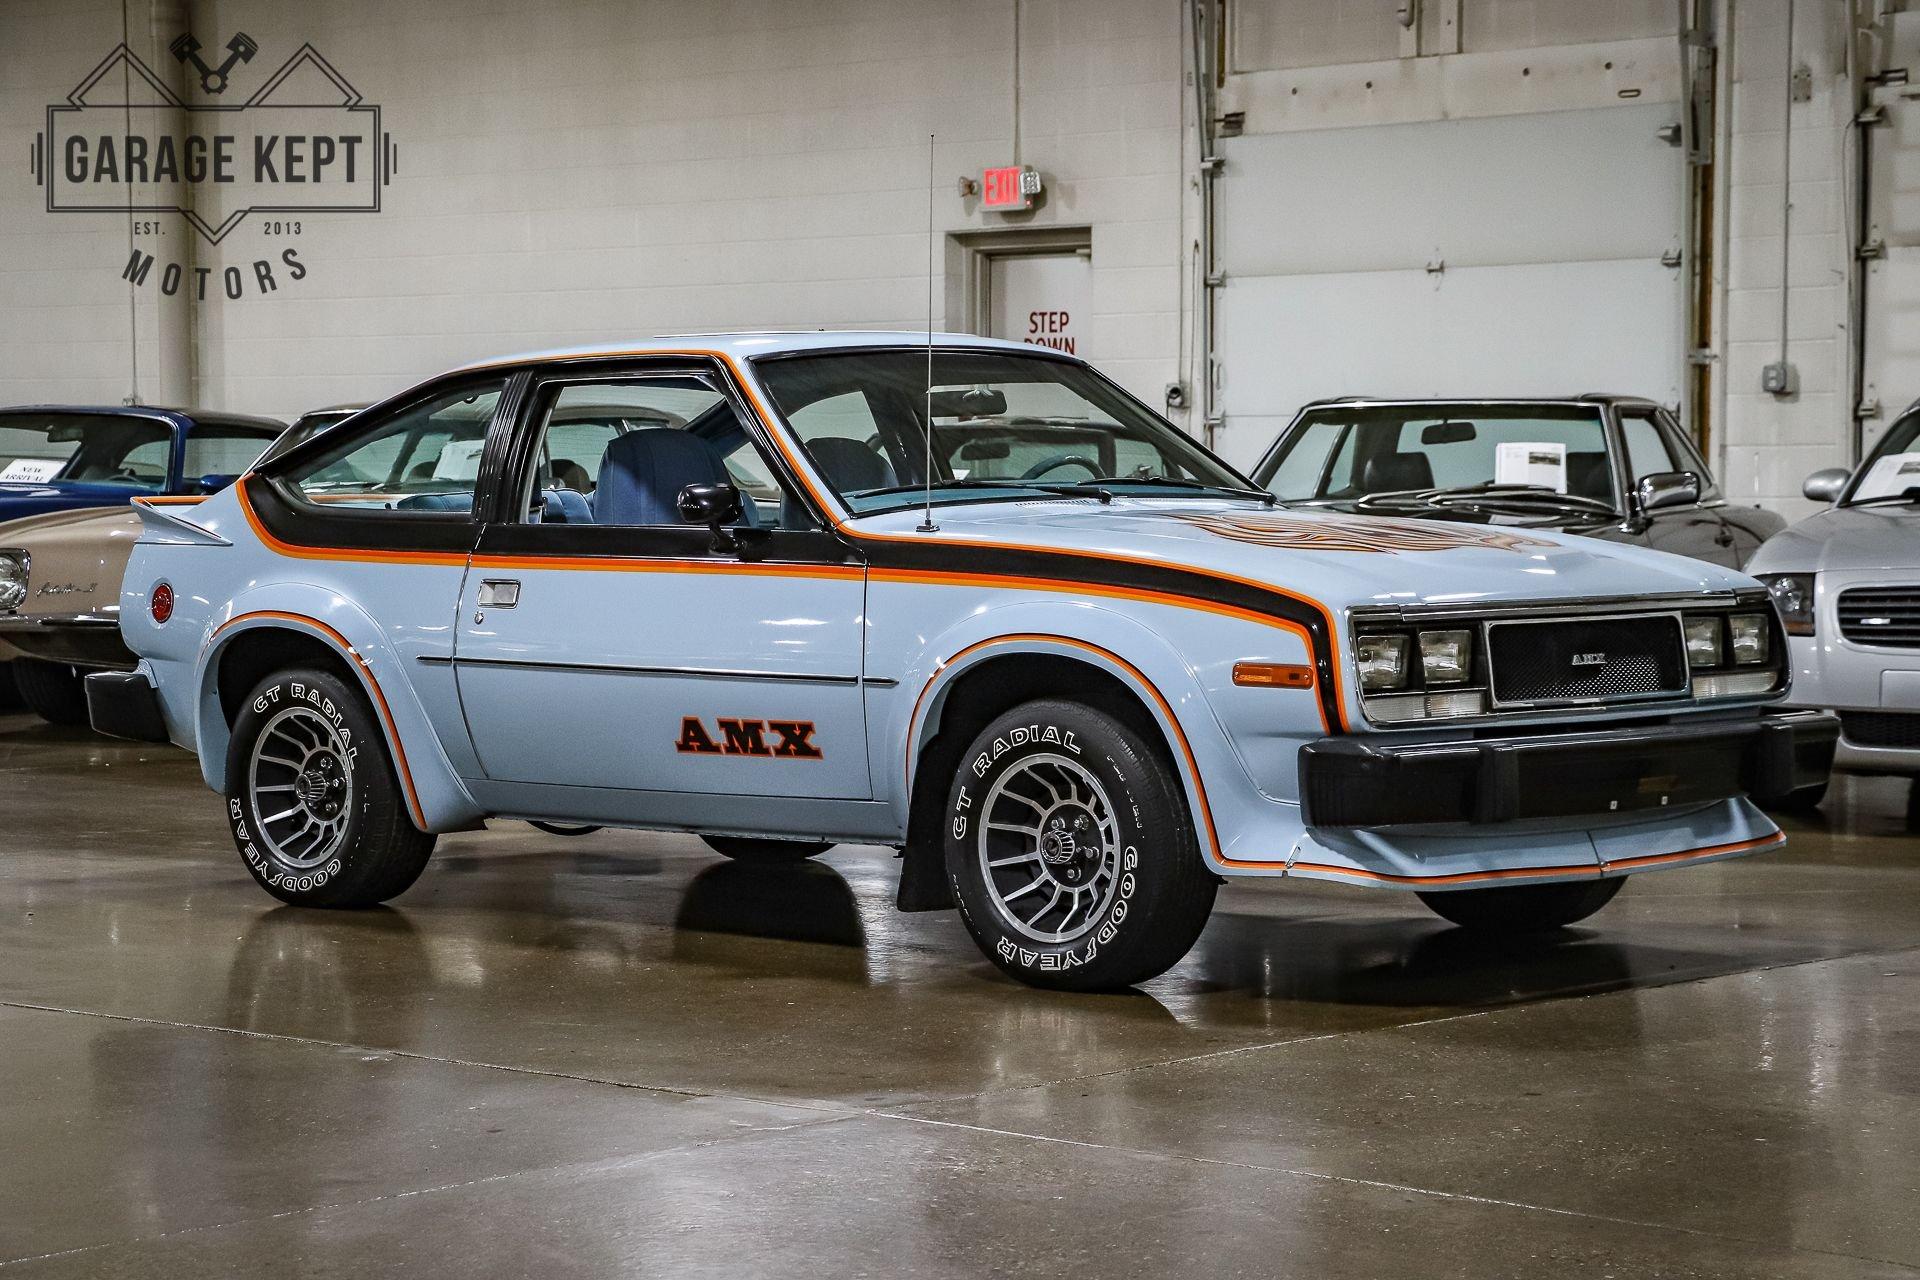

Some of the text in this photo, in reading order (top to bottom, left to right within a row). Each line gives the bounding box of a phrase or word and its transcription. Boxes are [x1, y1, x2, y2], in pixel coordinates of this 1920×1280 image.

[984, 168, 1019, 205] EXIT
[1029, 311, 1069, 333] STEP
[1024, 337, 1074, 355] WN
[1572, 653, 1606, 665] AMX
[291, 683, 358, 771] RADIAL
[674, 716, 824, 760] AMX
[972, 725, 1082, 778] RADIAL
[997, 846, 1139, 972] GOODYEAR
